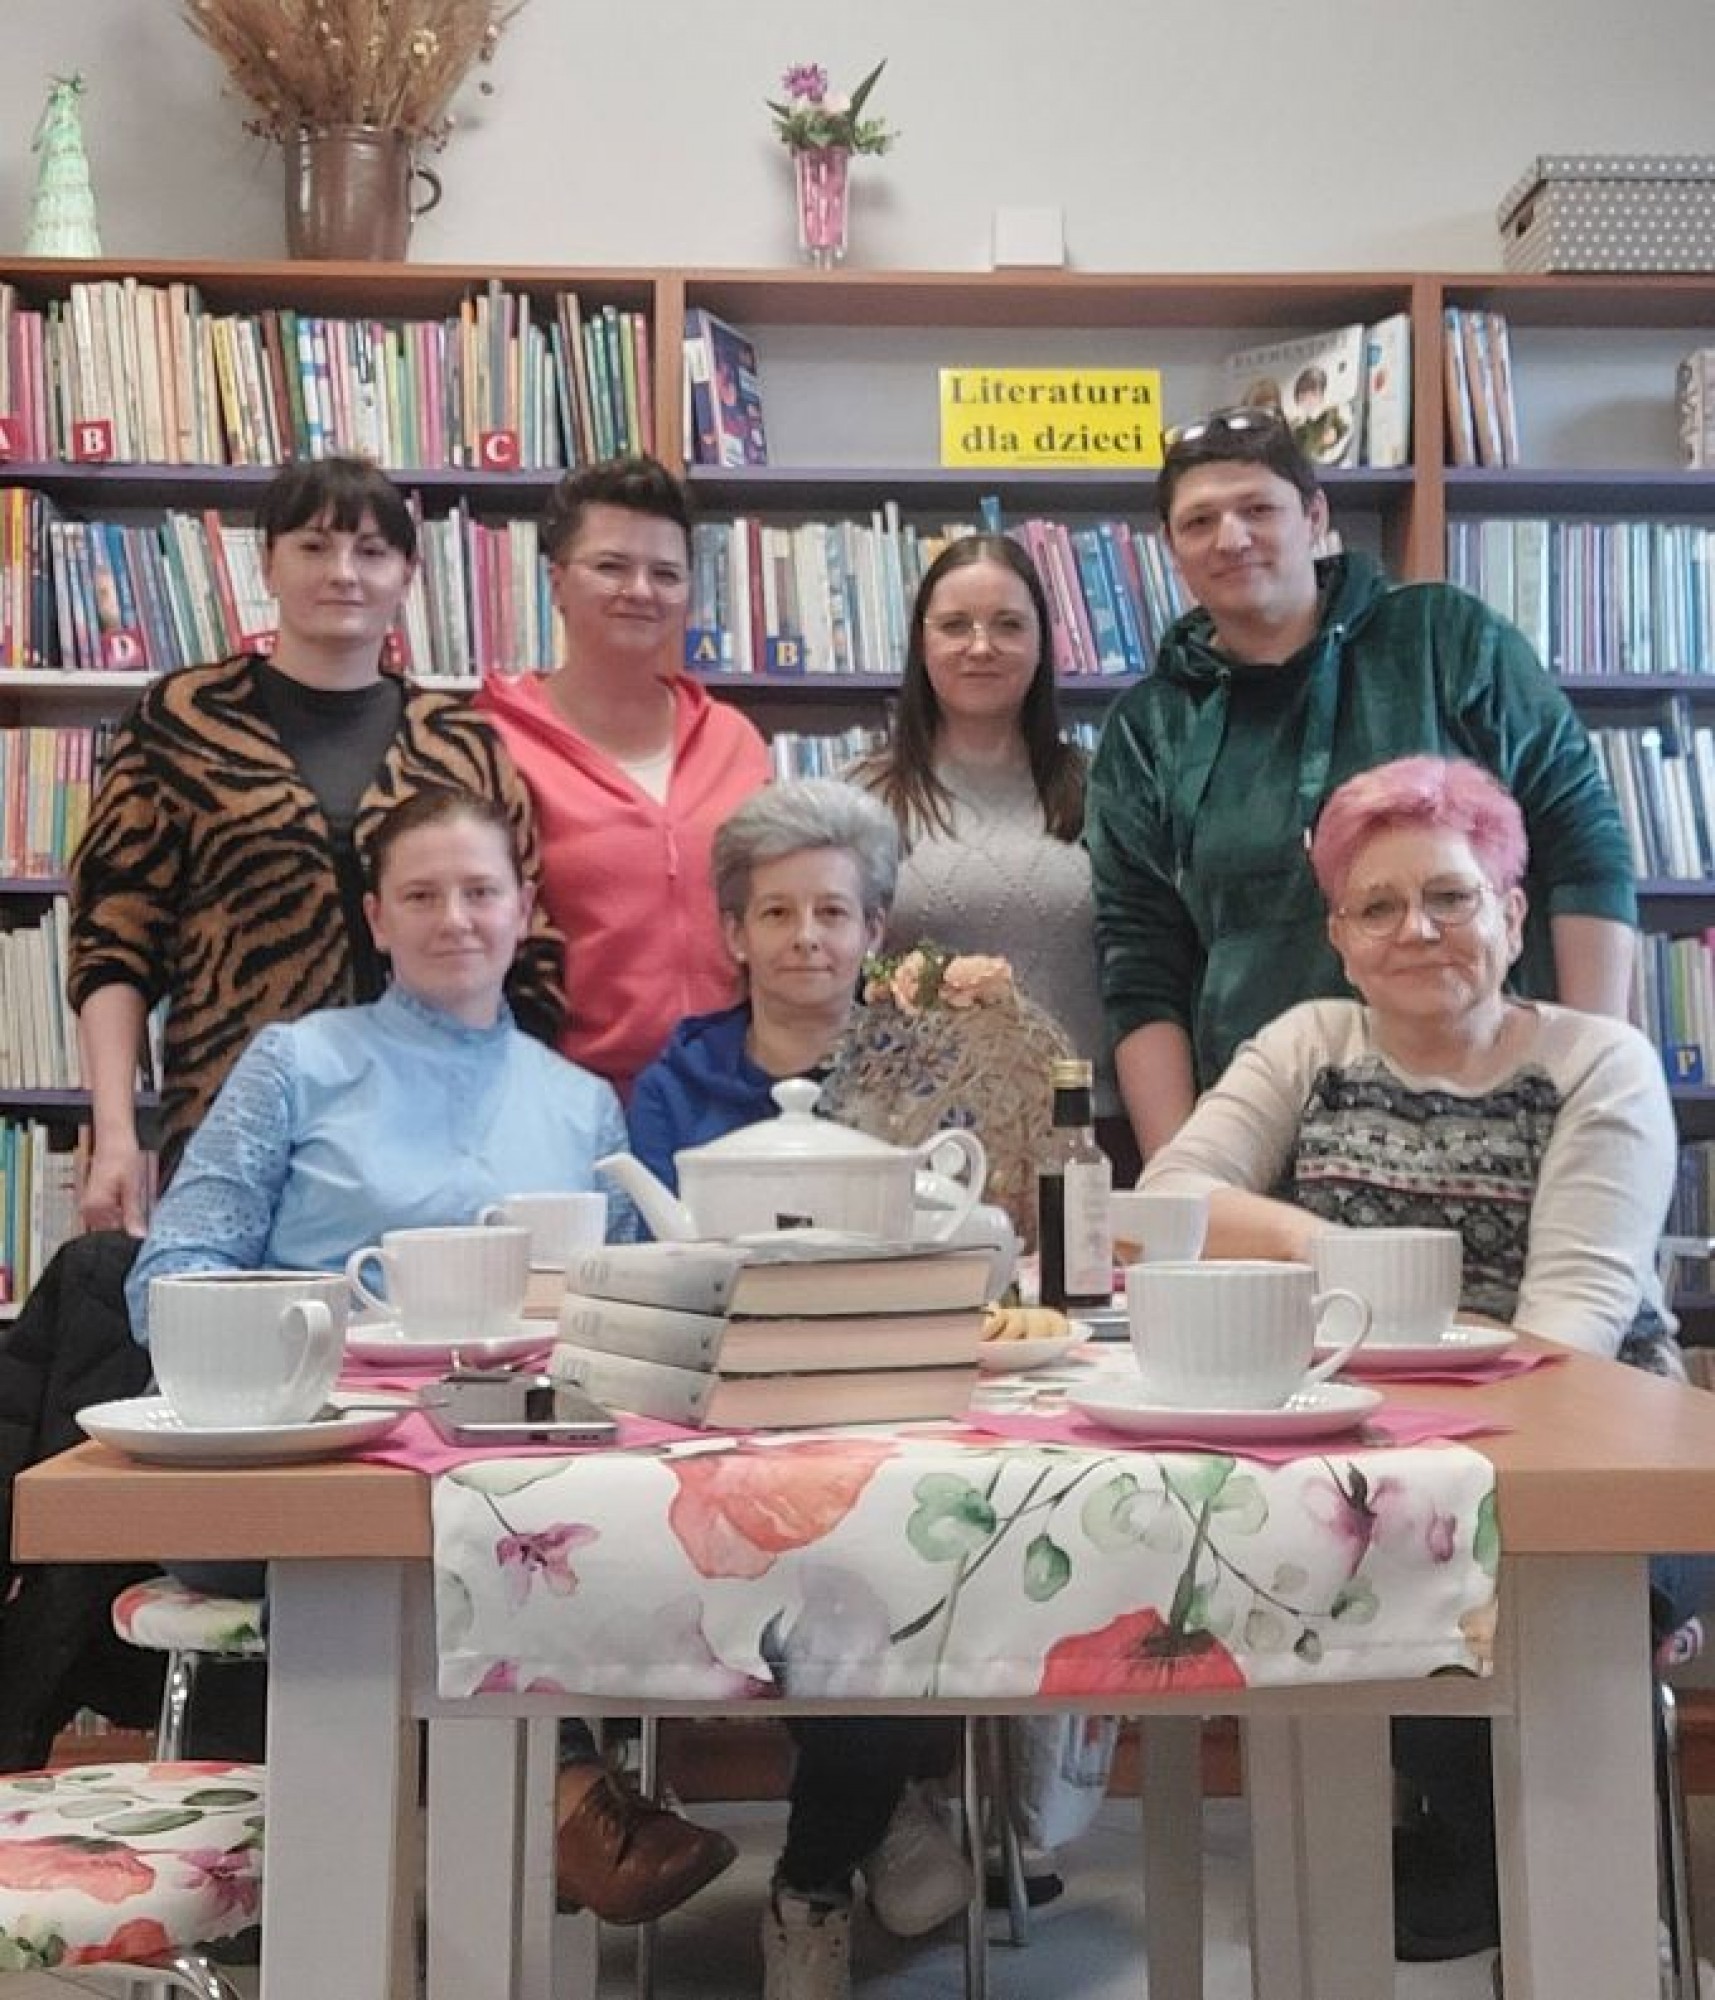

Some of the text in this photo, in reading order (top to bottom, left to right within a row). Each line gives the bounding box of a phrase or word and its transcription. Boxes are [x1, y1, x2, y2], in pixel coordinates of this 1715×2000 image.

[952, 376, 1151, 404] Literatura
[80, 428, 105, 454] B
[486, 435, 511, 462] C
[961, 424, 1143, 452] dla dzieci
[111, 635, 138, 661] D
[693, 634, 717, 660] A
[776, 641, 798, 666] B
[1676, 1050, 1696, 1076] P
